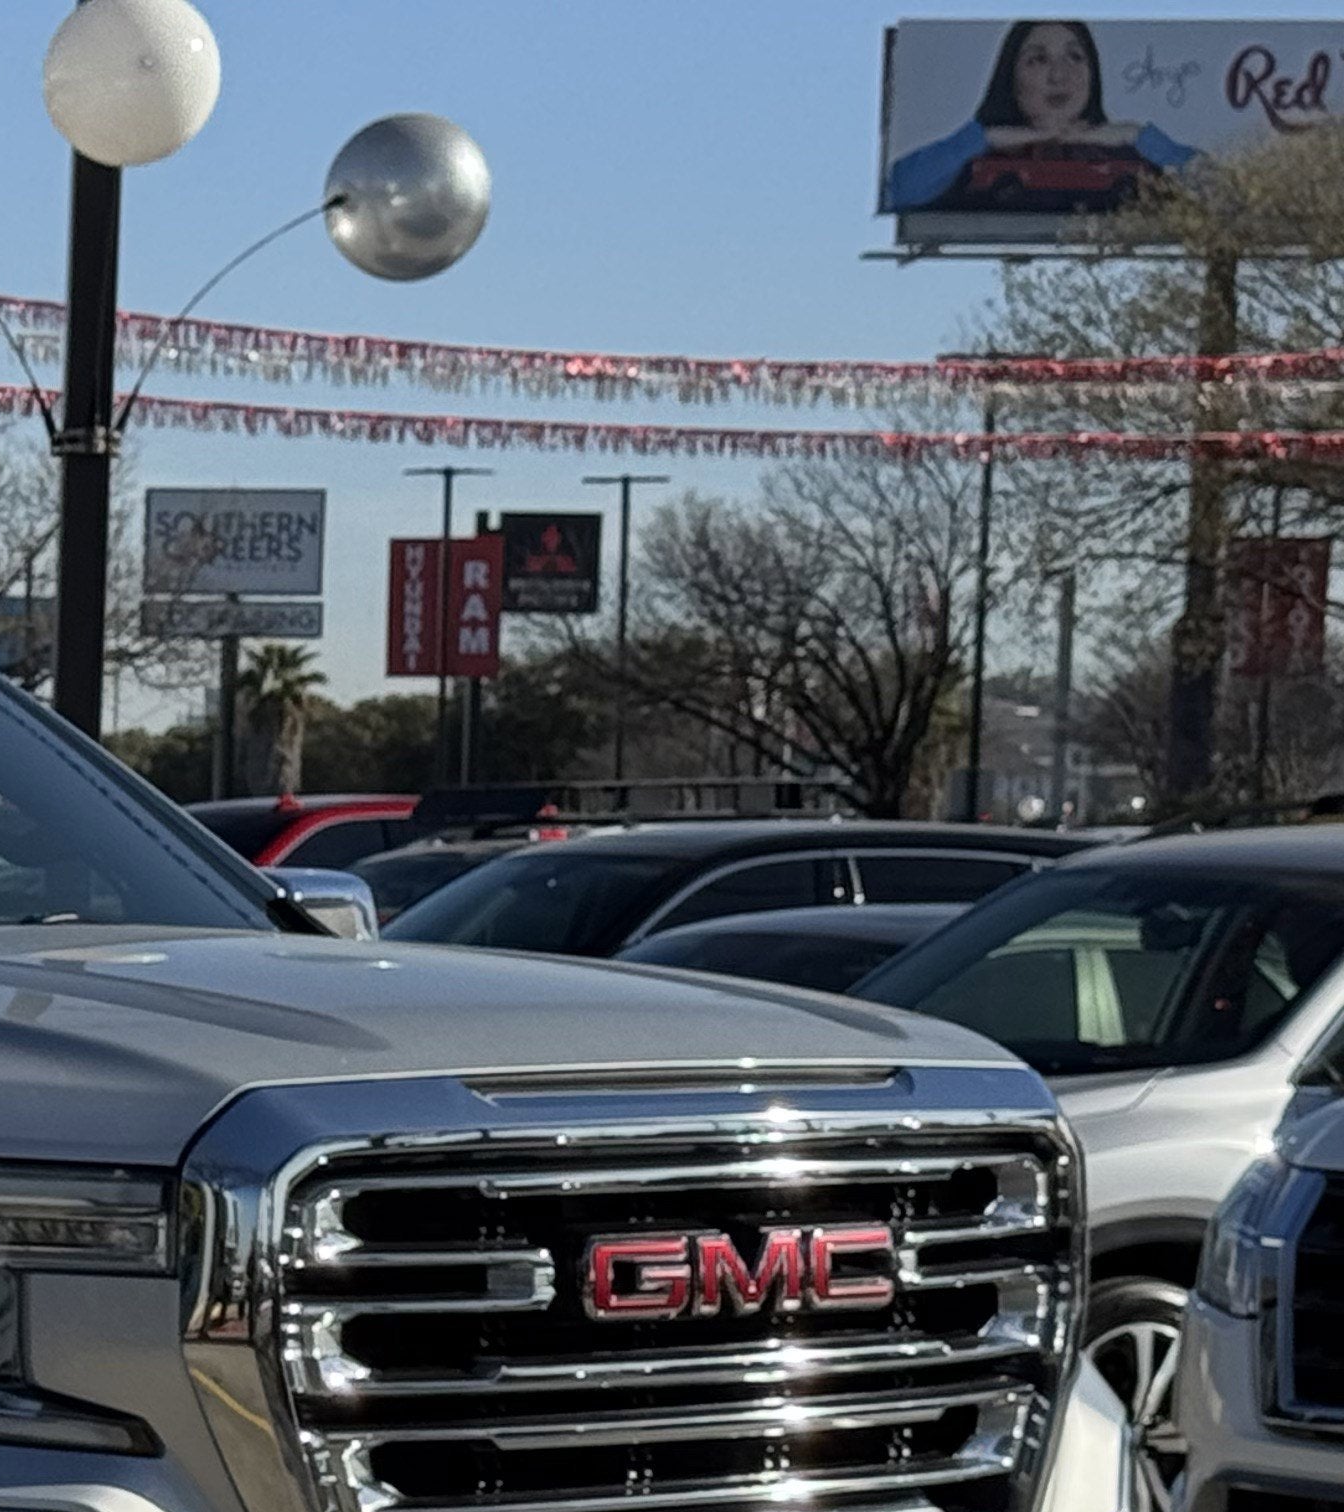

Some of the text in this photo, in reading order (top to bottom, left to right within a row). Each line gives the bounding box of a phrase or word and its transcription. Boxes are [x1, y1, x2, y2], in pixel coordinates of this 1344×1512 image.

[1226, 44, 1331, 135] Red
[154, 510, 319, 538] SOUTHERN
[459, 559, 490, 655] RAM
[585, 1224, 895, 1320] GMC
